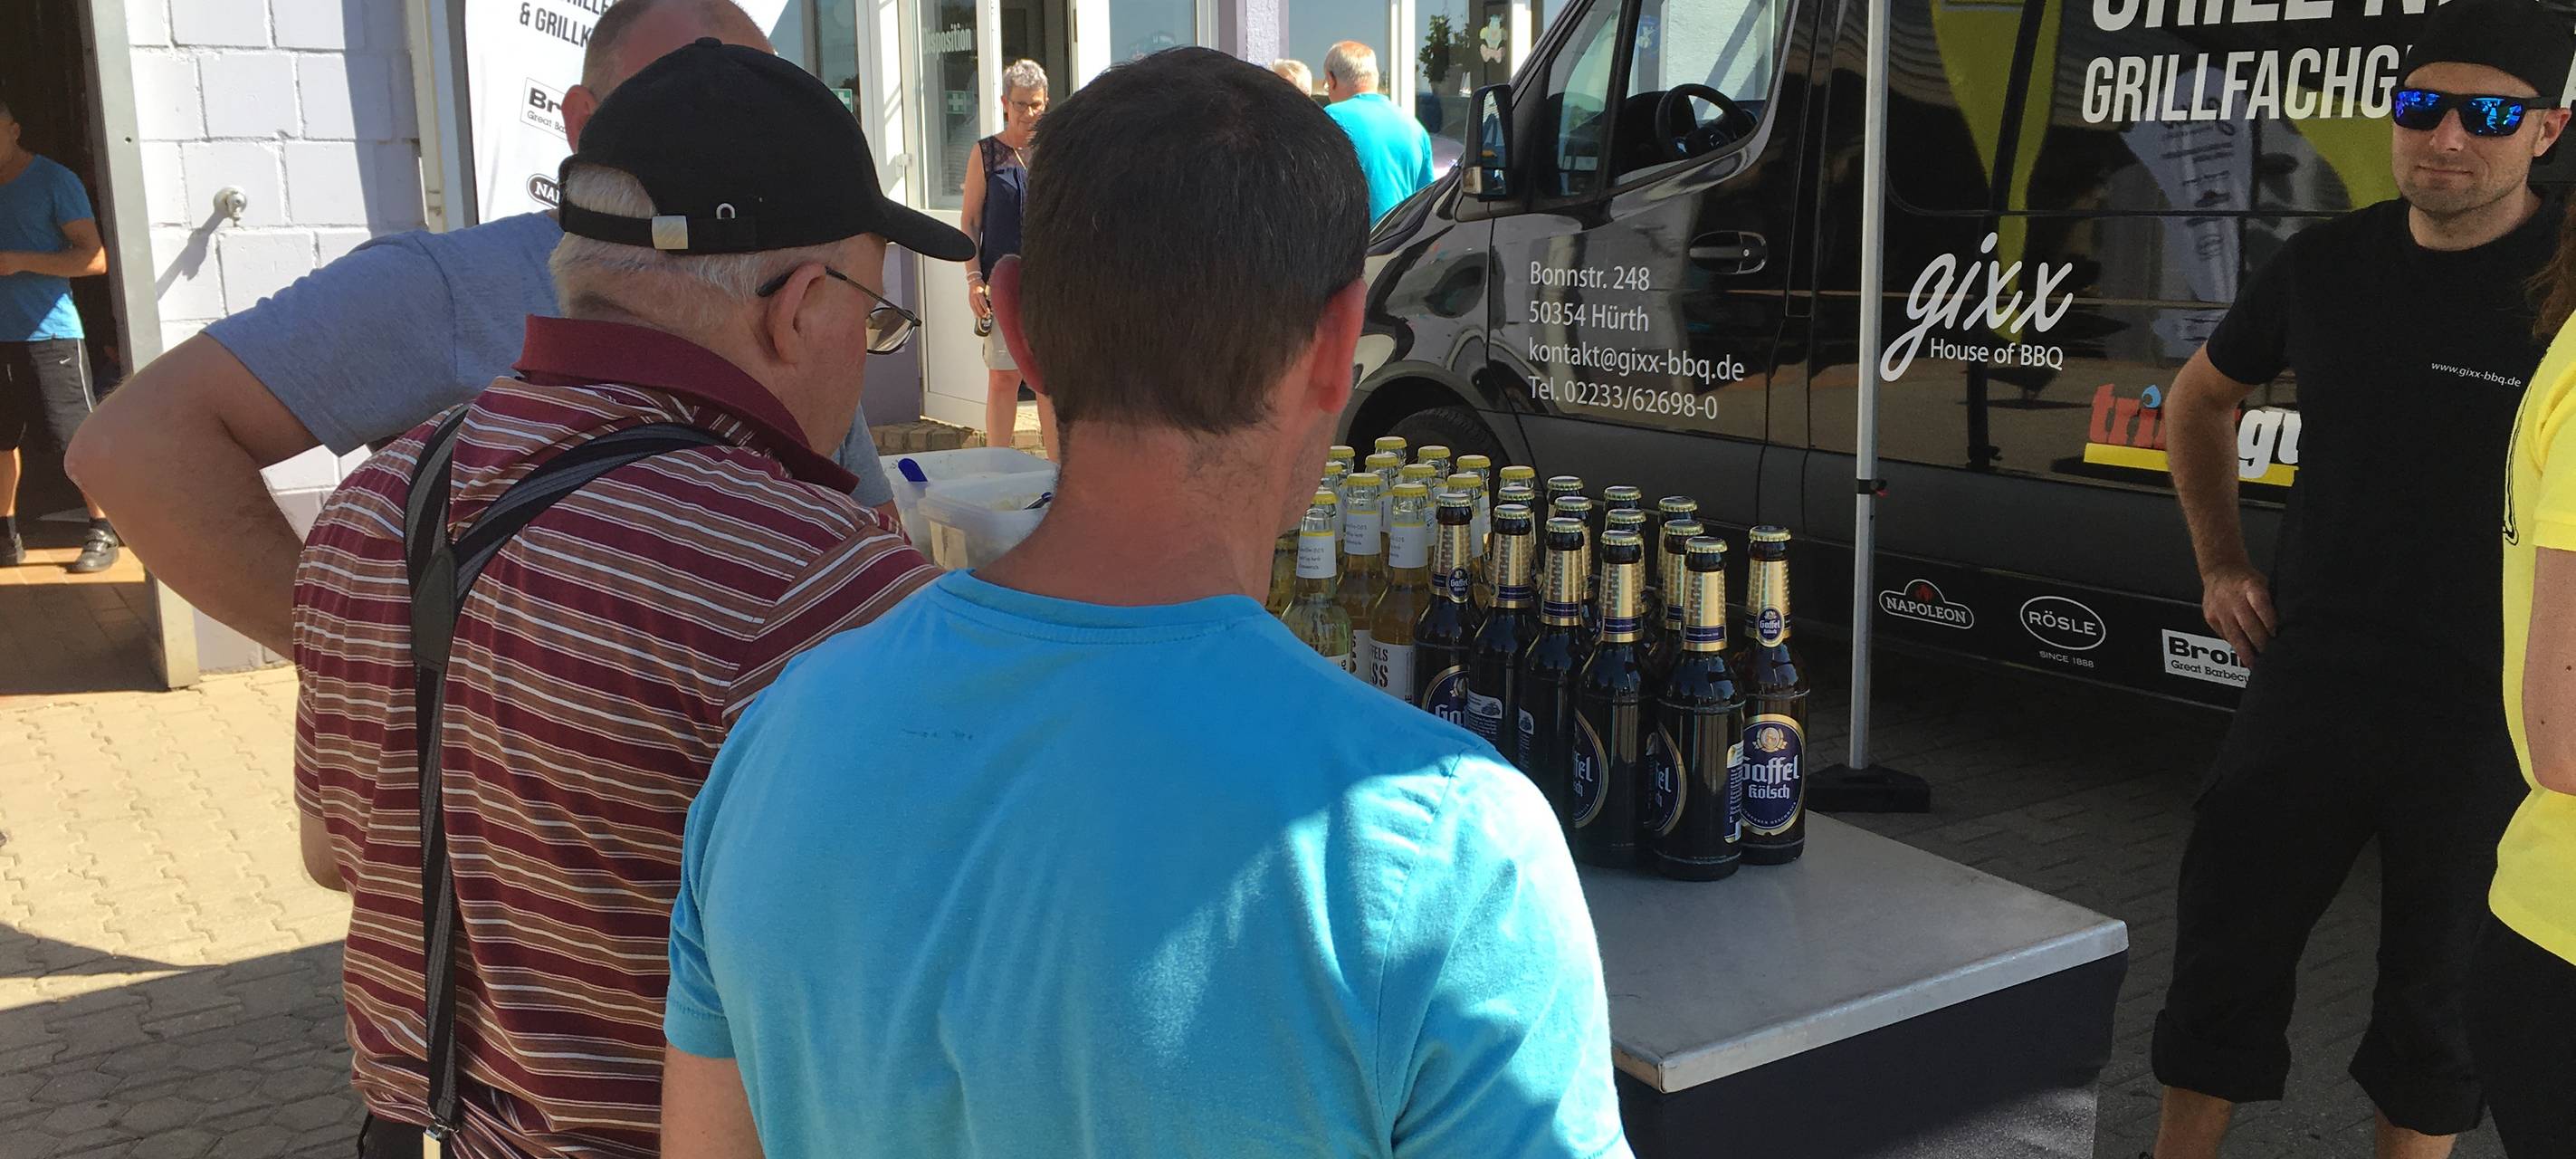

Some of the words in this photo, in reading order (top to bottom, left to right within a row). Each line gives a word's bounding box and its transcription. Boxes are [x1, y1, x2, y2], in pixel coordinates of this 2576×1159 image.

[520, 2, 530, 26] &
[534, 6, 594, 48] GRILLK
[922, 23, 971, 60] Disposition
[2082, 44, 2408, 124] GRILLFACHG
[529, 87, 562, 113] Br
[554, 121, 566, 133] Ba
[1530, 261, 1608, 290] Bonnstr.
[1613, 266, 1650, 292] 248
[1528, 301, 1586, 327] 50354
[1591, 303, 1649, 331] Hürth
[1880, 232, 2074, 382] gixx
[1528, 337, 1745, 384] kontakt@gixx-bbq.de
[1931, 338, 1989, 362] House
[1994, 342, 2016, 364] of
[2020, 345, 2064, 370] BBQ
[2431, 363, 2522, 387] www.gixx-bbq.de
[1528, 376, 1560, 401] Tel.
[1565, 380, 1718, 419] 02233/62698-0
[1885, 597, 1967, 624] NAPOLEON
[2028, 610, 2097, 636] RÖSLE
[2039, 650, 2069, 664] SINCE
[2072, 656, 2094, 668] 1888
[2168, 636, 2239, 667] Broi
[1371, 663, 1388, 687] SS
[2171, 660, 2202, 674] Great
[1435, 704, 1463, 726] Ga
[1748, 784, 1790, 800] Kölsch
